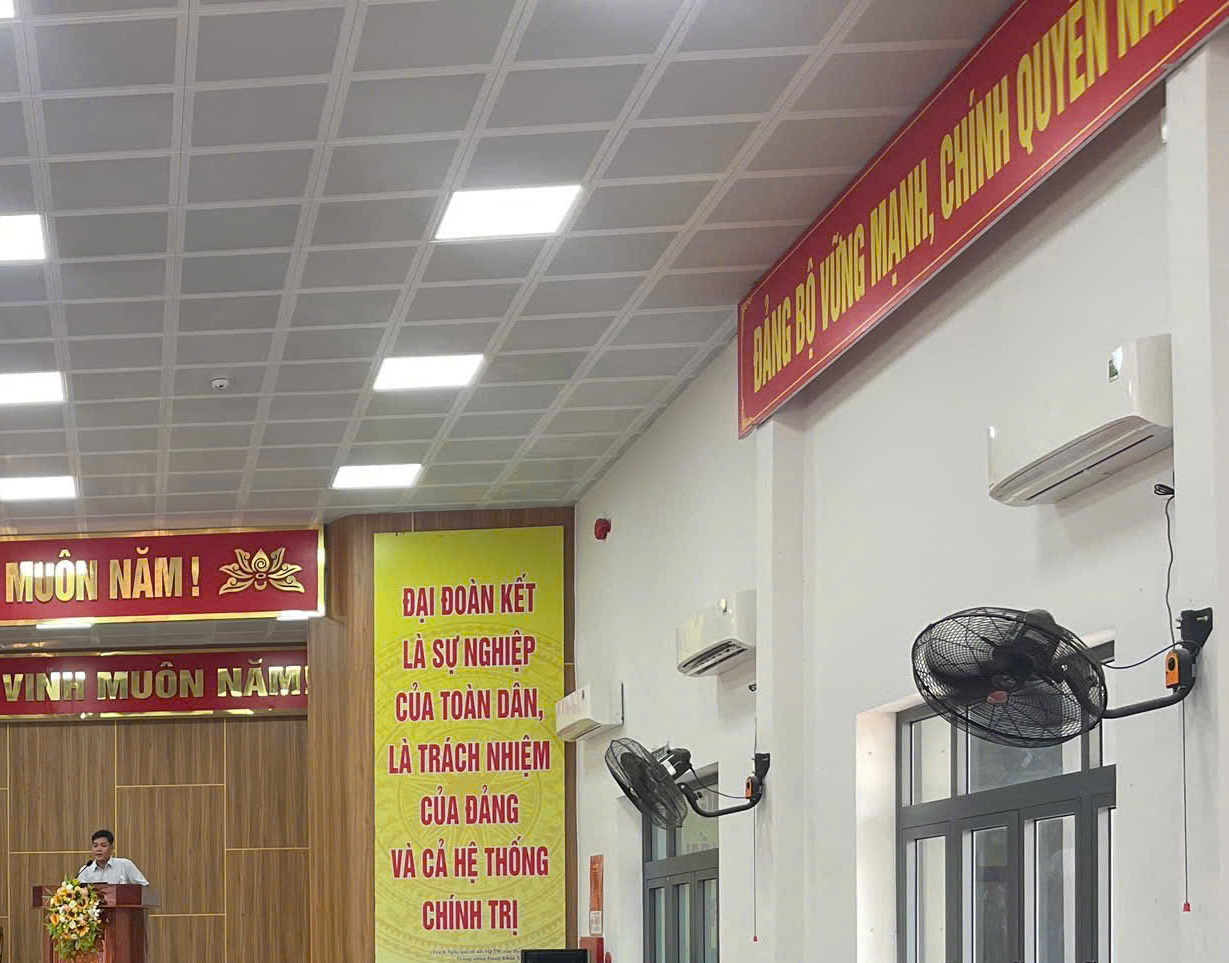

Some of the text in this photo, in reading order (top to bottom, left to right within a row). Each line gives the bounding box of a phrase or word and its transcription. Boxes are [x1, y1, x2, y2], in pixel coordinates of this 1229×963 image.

[753, 294, 792, 394] ĐẢNG
[795, 258, 817, 359] BỘ
[819, 223, 866, 331] VỮNG
[869, 158, 935, 286] MẠNH,
[940, 74, 1010, 220] CHÍNH
[6, 549, 98, 603] MUÔN
[403, 573, 536, 623] ĐẠI ĐOÀN KẾT
[403, 630, 535, 674] LÀ SỰ NGHIỆP
[1, 671, 86, 701] VINH
[97, 661, 204, 701] MUÔN
[396, 681, 543, 722] CỦA TOÀN DÂN,
[389, 735, 550, 777] LÀ TRÁCH NHIỆM
[420, 784, 519, 825] CỦA ĐẢNG
[391, 836, 549, 883] VÀ CẢ HỆ THỐNG
[422, 893, 518, 936] CHÍNH TRỊ
